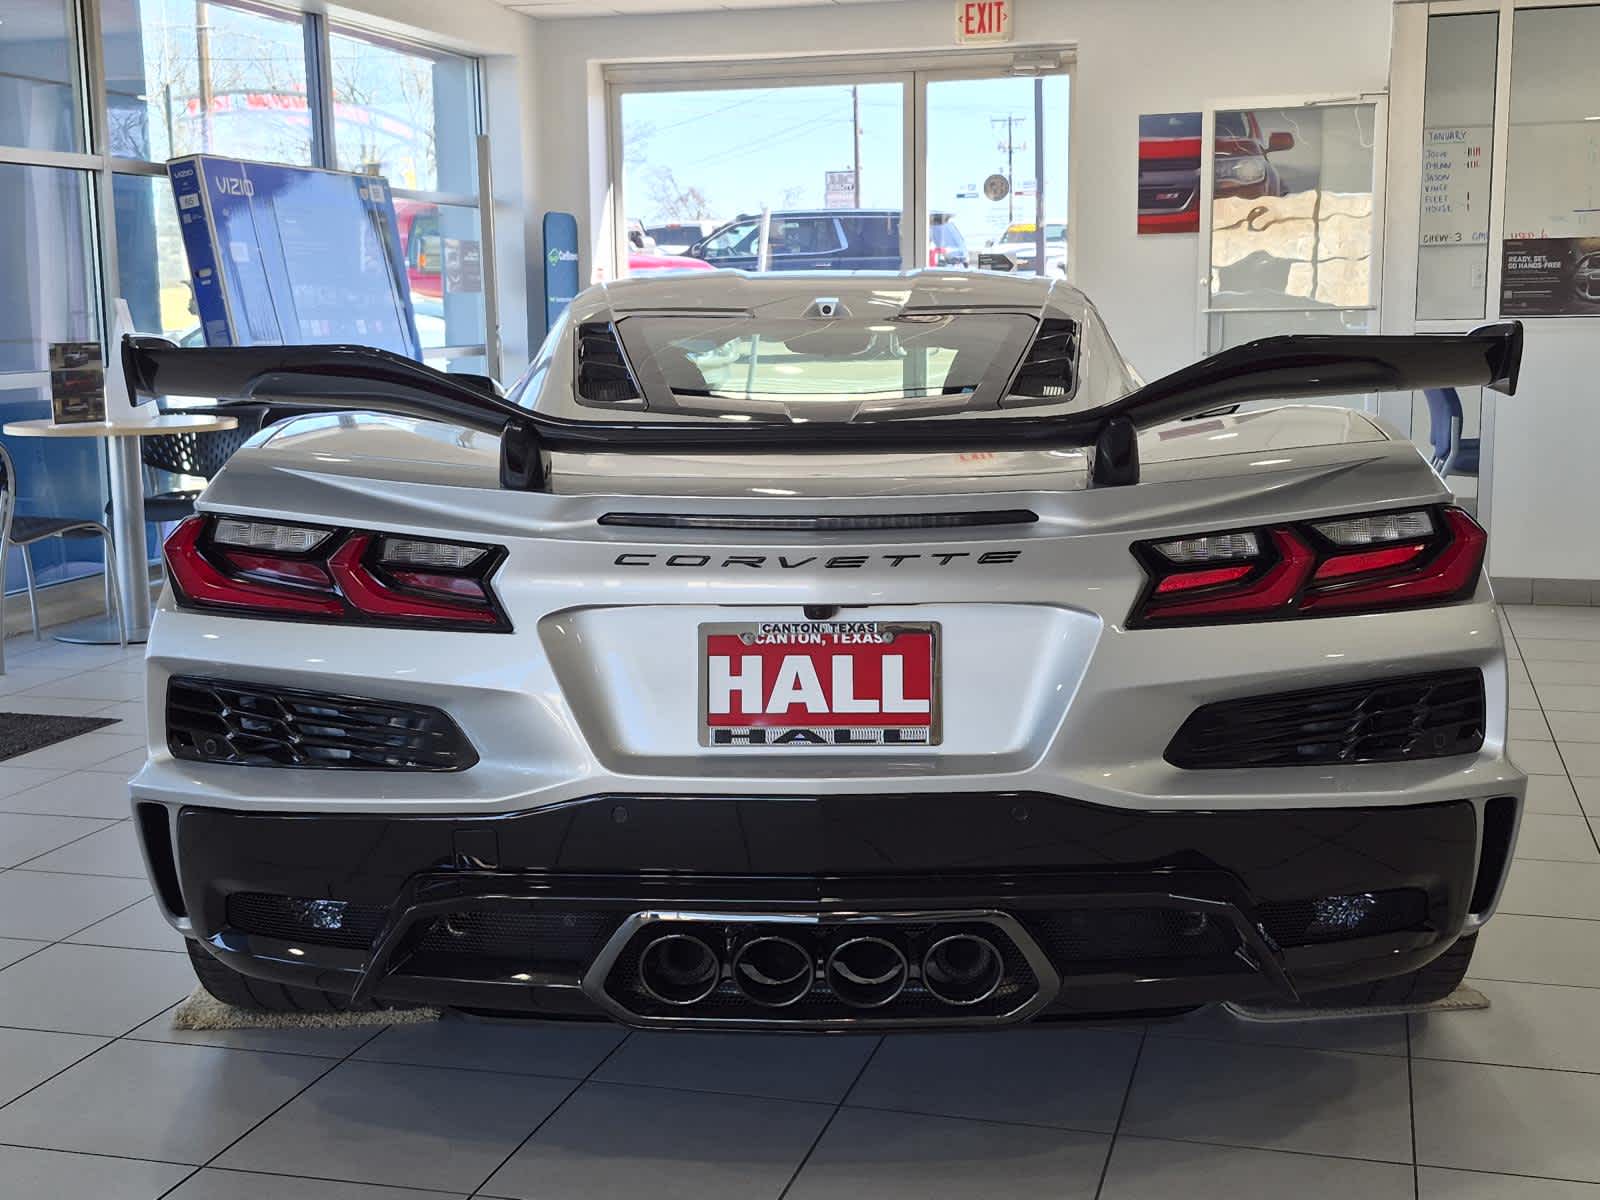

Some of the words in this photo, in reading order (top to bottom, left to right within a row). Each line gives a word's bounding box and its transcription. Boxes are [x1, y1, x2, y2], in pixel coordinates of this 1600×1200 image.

[965, 2, 1004, 34] EXIT
[1429, 130, 1467, 141] JANUARY
[215, 176, 254, 196] VIZIO
[1455, 232, 1463, 242] 3
[614, 551, 1022, 568] CORVETTE
[831, 622, 876, 633] TEXAS
[755, 633, 826, 646] CANTON,
[832, 633, 882, 645] TEXAS
[709, 655, 929, 713] HALL
[715, 729, 926, 743] HALL
